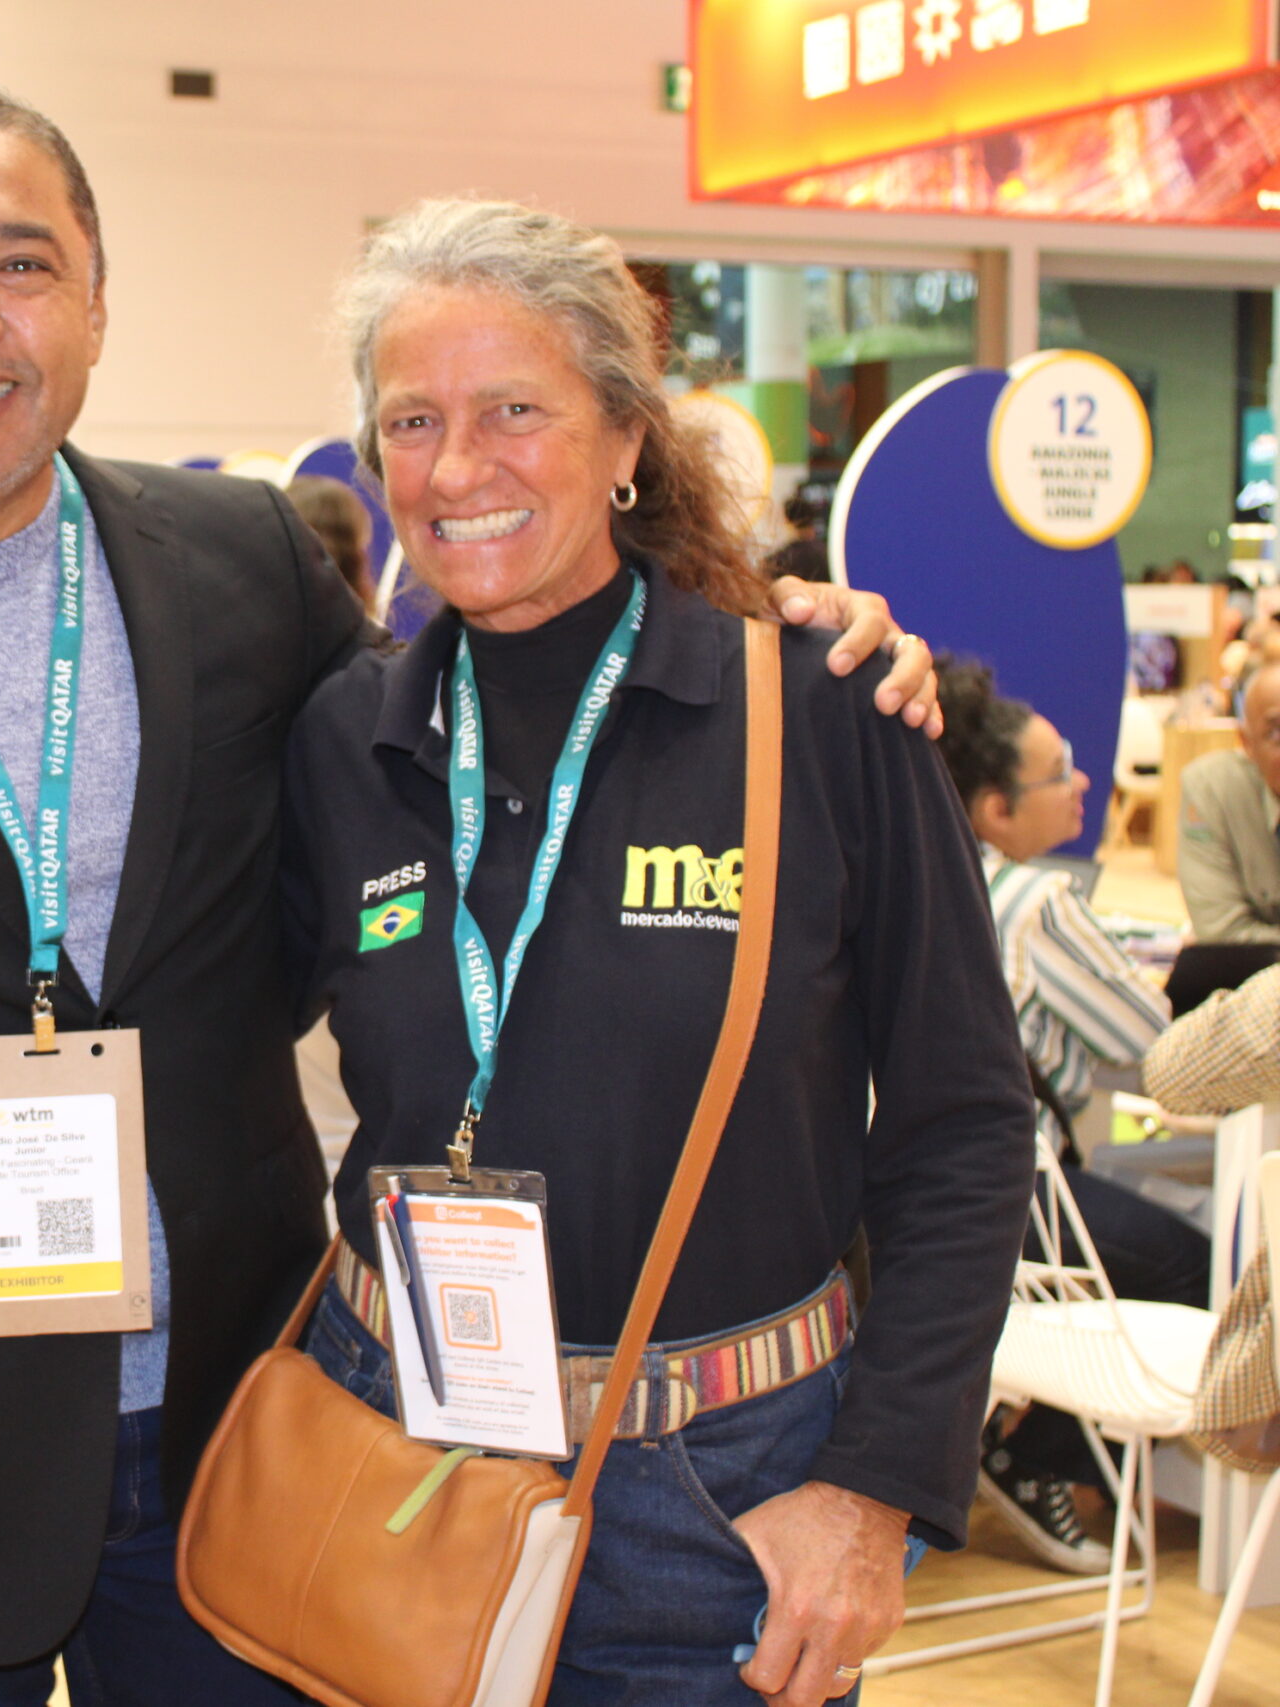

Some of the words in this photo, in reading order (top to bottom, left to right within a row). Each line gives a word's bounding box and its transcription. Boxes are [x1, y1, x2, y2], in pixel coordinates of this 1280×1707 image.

[1052, 393, 1097, 436] 12
[61, 521, 80, 629] visitQATAR
[49, 658, 73, 777] visitQATAR
[457, 679, 477, 770] visitQATAR
[571, 652, 627, 753] visitQATAR
[39, 808, 61, 928] visitQATAR
[361, 861, 427, 901] PRESS
[534, 784, 574, 904] visitQATAR
[13, 1107, 54, 1122] wtm
[0, 1275, 64, 1288] EXHIBITOR
